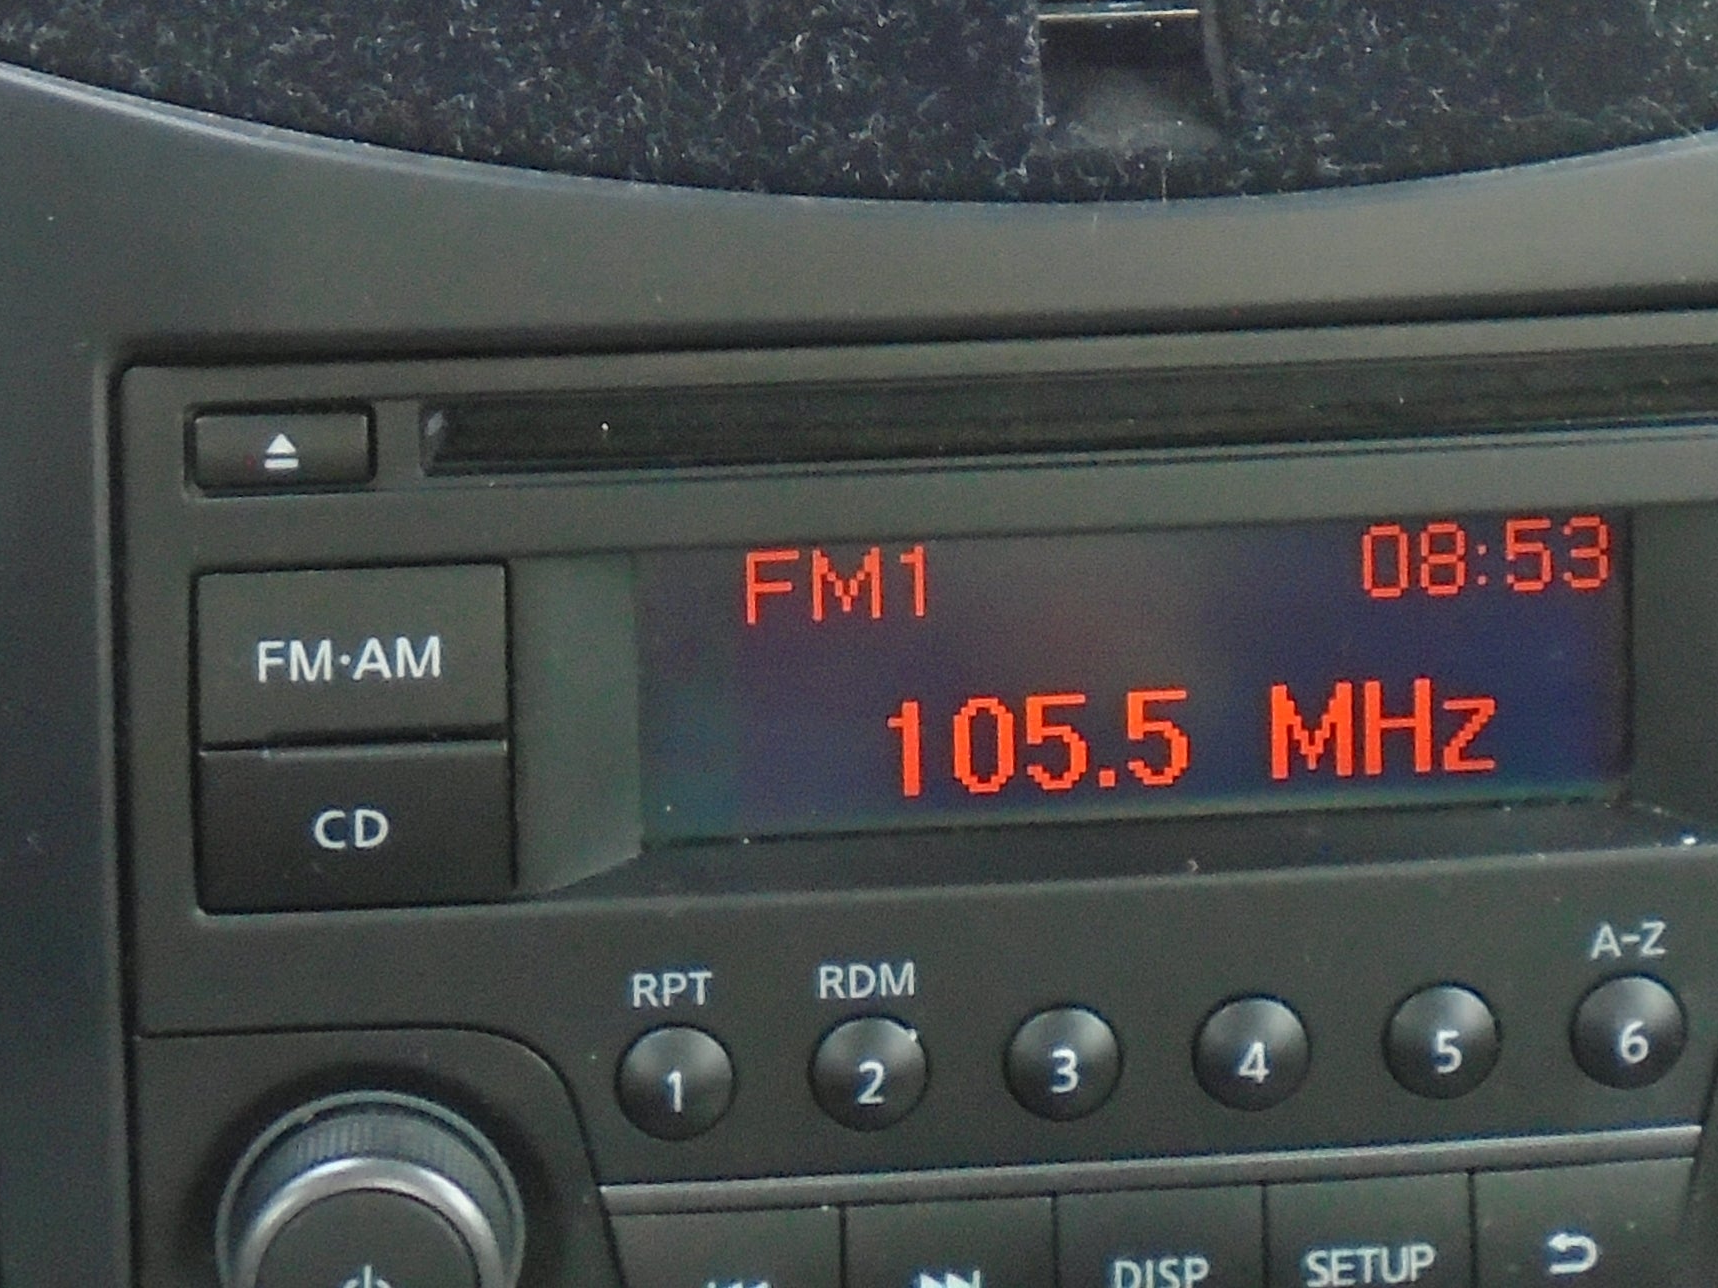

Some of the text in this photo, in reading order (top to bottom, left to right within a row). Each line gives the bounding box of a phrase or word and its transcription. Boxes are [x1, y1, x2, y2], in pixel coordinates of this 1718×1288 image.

[1360, 516, 1611, 599] 08:53
[745, 545, 928, 625] FM1
[887, 677, 1496, 797] 105.5 MHz
[313, 809, 389, 851] CD
[1590, 921, 1667, 960] A-Z
[632, 970, 713, 1008] RPT
[818, 961, 916, 1000] RDM
[1237, 1040, 1270, 1085] 4
[1435, 1030, 1464, 1074] 5
[1618, 1021, 1649, 1065] 6
[665, 1070, 683, 1114] 1
[857, 1060, 886, 1105] 2
[1050, 1048, 1080, 1094] 3
[1113, 1255, 1210, 1288] DISP
[1305, 1242, 1437, 1288] SETUP
